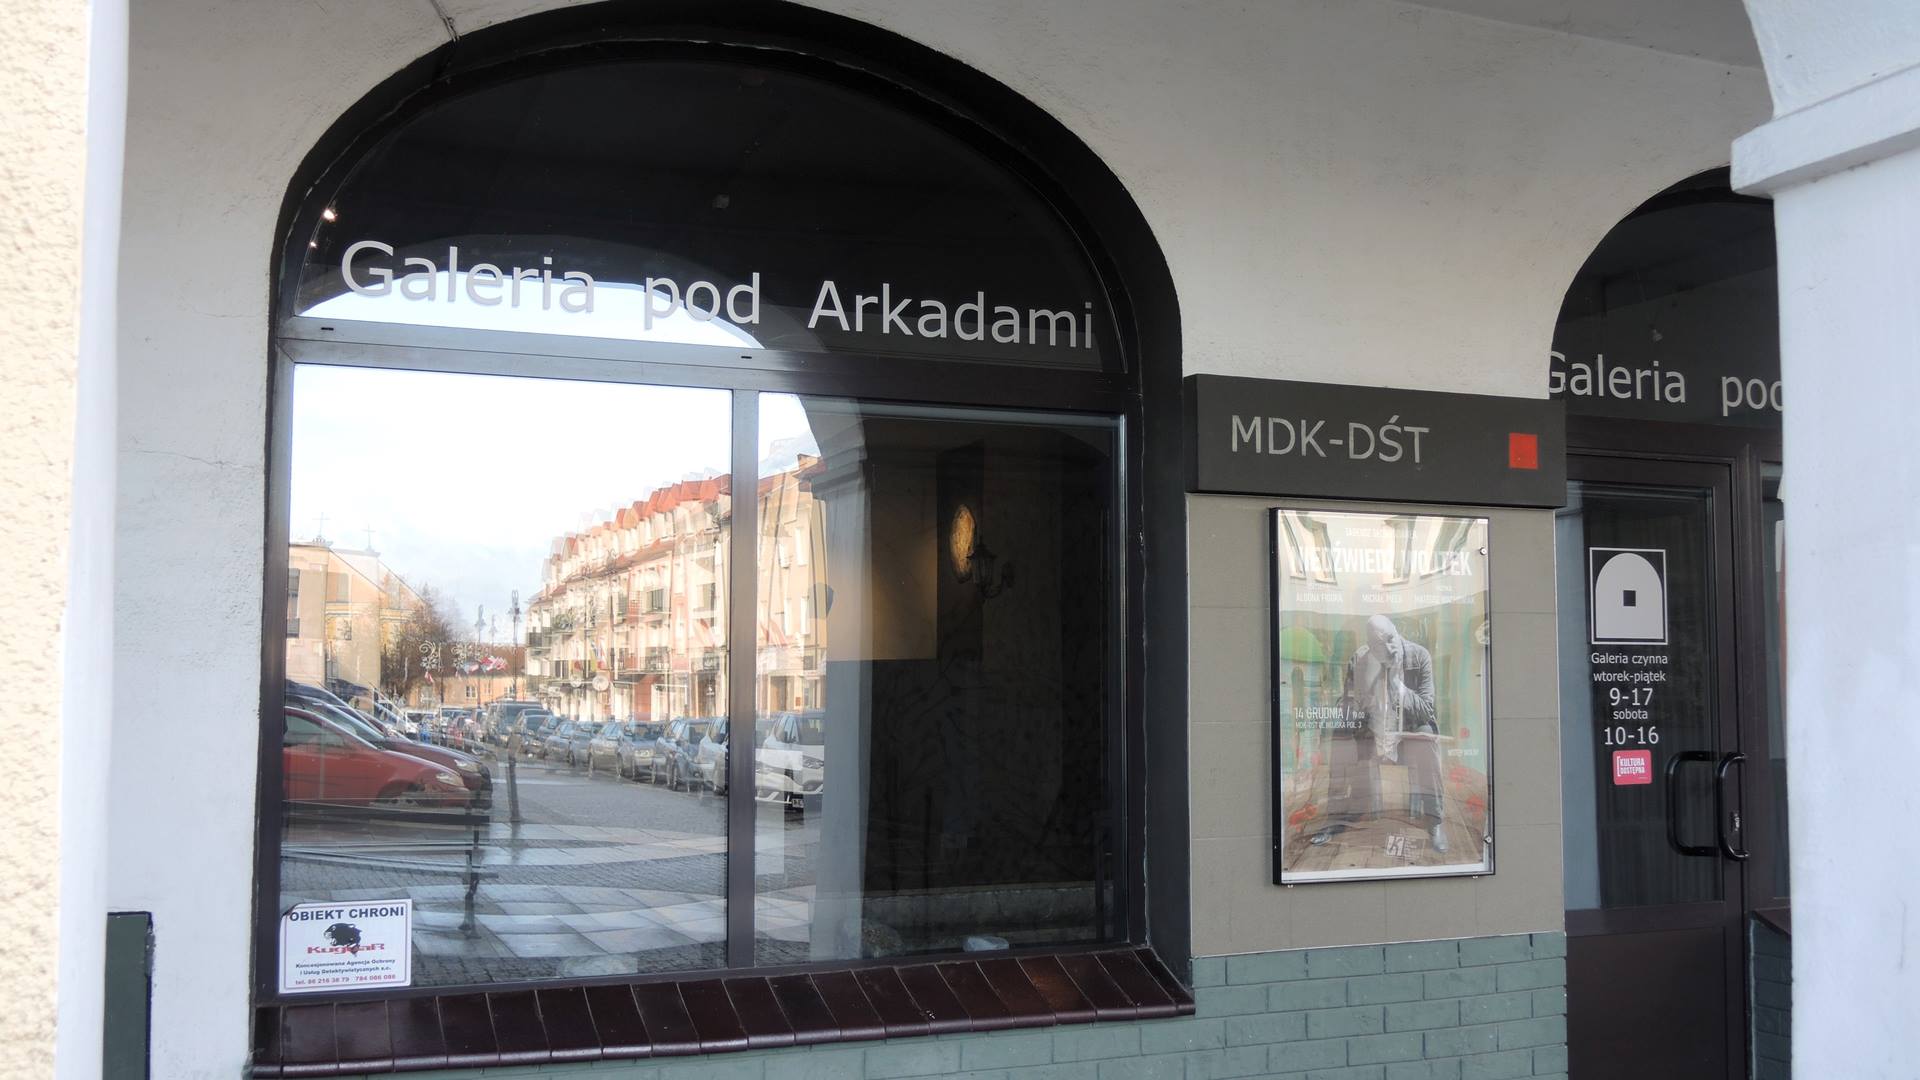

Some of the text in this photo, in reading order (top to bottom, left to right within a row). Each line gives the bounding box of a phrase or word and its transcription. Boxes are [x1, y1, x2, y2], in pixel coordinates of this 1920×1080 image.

[341, 240, 1092, 349] Galeria pod Arkadami
[1231, 414, 1430, 463] MDK-DŚT
[1591, 652, 1668, 666] Galeria czynna
[1593, 670, 1666, 684] wtorek-piątek
[1609, 687, 1653, 706] 9-17
[1306, 707, 1343, 719] GRUDNIA
[1613, 709, 1648, 720] sobota
[1604, 726, 1659, 745] 10-16
[290, 906, 404, 921] OBIEKT CHRONI
